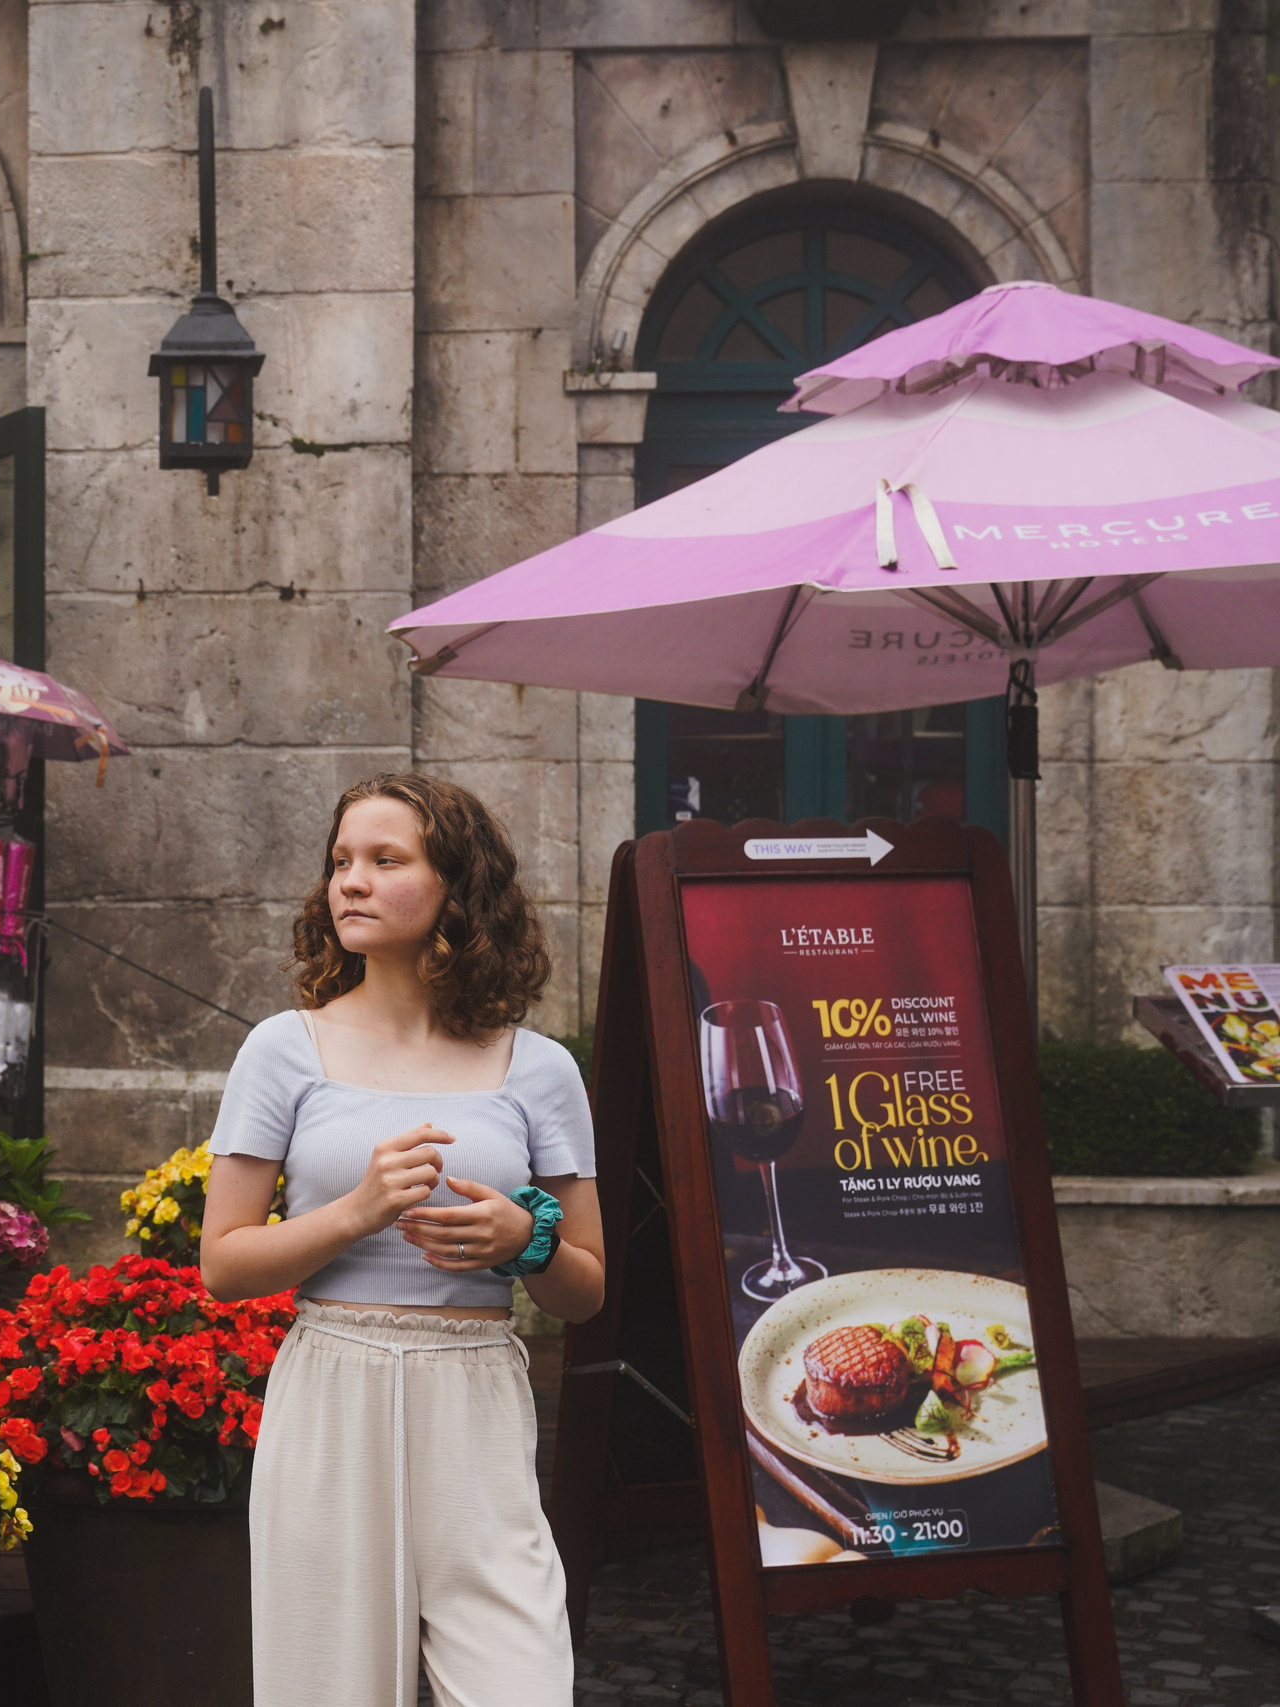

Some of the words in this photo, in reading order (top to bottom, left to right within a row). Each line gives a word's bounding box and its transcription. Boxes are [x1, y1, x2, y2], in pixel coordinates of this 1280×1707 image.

[952, 501, 1280, 541] MERCURE
[1049, 532, 1189, 549] HOTELS
[753, 843, 781, 854] THIS
[784, 843, 813, 854] WAY
[781, 925, 875, 946] L'ÉTABLE
[799, 948, 859, 956] RESTAURANT
[891, 996, 955, 1010] DISCOUNT
[812, 998, 892, 1038] 10%
[894, 1012, 919, 1024] ALL
[920, 1011, 957, 1023] WINE
[904, 1070, 966, 1092] FREE
[825, 1072, 845, 1130] 1
[848, 1071, 973, 1130] Glass
[834, 1121, 882, 1171] of
[881, 1127, 989, 1169] wine
[877, 1178, 885, 1190] 1
[886, 1177, 901, 1190] LY
[943, 1174, 981, 1187] VANG
[949, 1202, 968, 1214] 와인
[865, 1510, 888, 1521] OPEN
[850, 1524, 896, 1545] 11:30
[912, 1519, 963, 1541] 21:00
